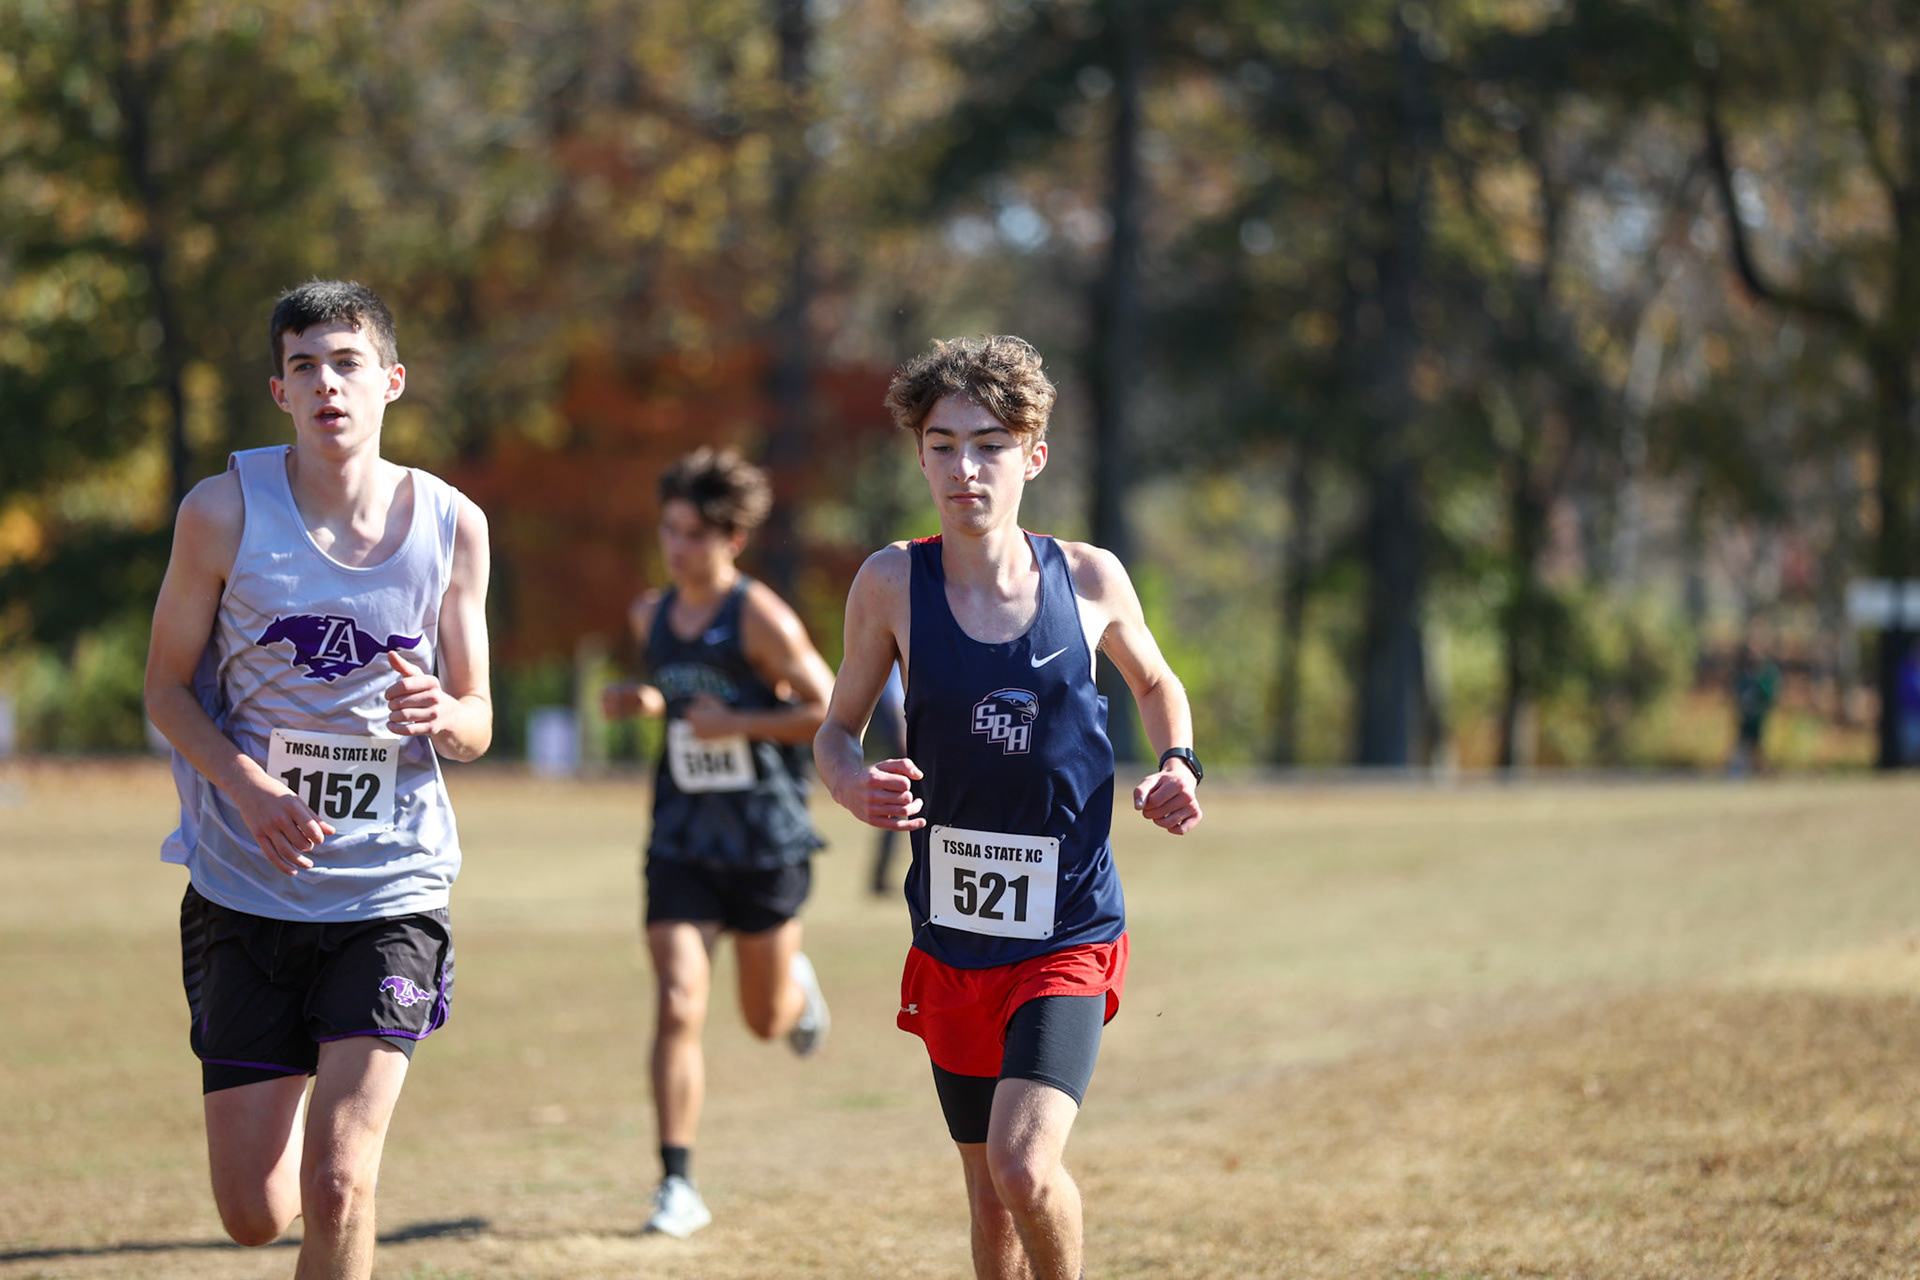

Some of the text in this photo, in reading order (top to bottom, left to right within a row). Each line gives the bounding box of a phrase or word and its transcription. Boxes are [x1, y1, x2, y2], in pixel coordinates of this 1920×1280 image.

[311, 618, 363, 666] LA
[975, 704, 1029, 751] SBA
[285, 741, 387, 762] TMSAA STATE XC
[281, 767, 380, 820] 1152
[942, 839, 1043, 863] TSSAA STATE XC
[953, 867, 1029, 922] 521
